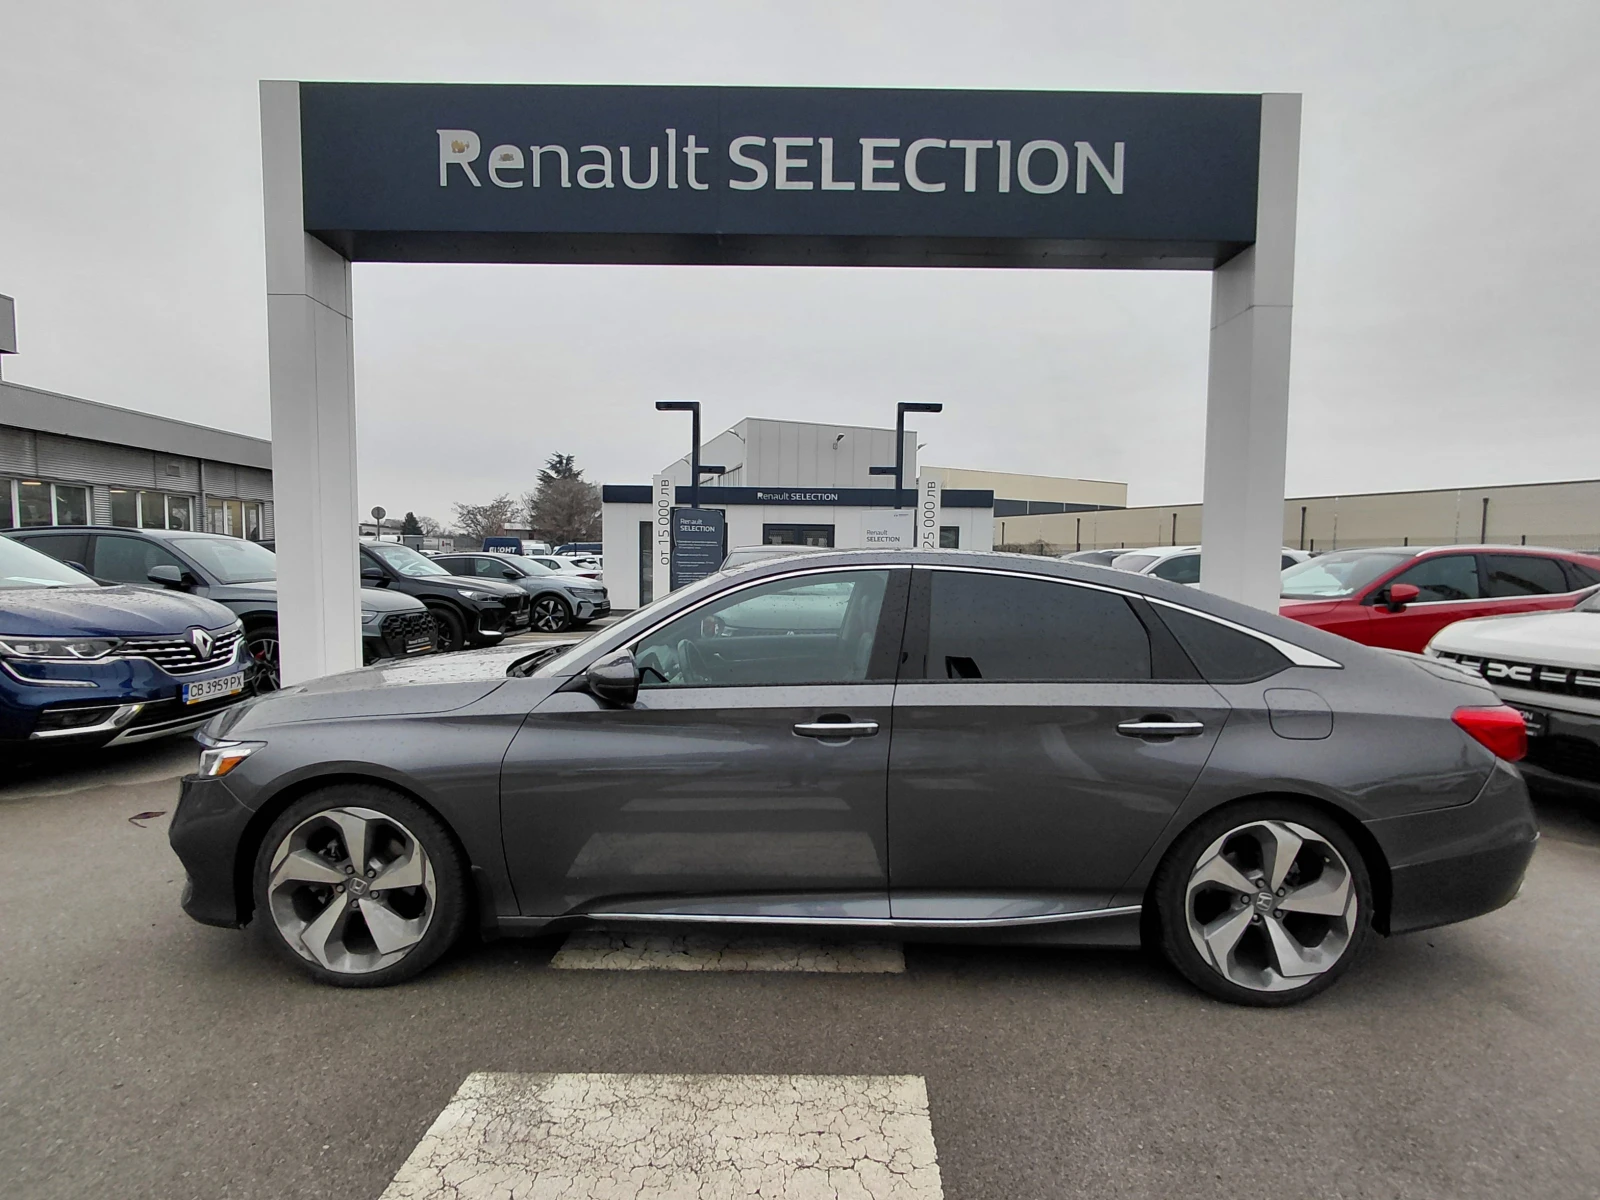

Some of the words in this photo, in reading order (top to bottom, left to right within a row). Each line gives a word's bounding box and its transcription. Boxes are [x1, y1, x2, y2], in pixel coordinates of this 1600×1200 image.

[436, 128, 710, 190] Renault
[728, 136, 1125, 194] SELECTION
[757, 492, 790, 501] Renault
[790, 493, 838, 501] SELECTION
[658, 500, 670, 526] 000
[923, 501, 936, 528] 000
[658, 530, 670, 546] 15
[680, 525, 716, 533] SELECTION
[923, 531, 935, 549] 25
[190, 683, 204, 697] CB
[205, 678, 229, 694] 3959
[230, 675, 242, 689] PX
